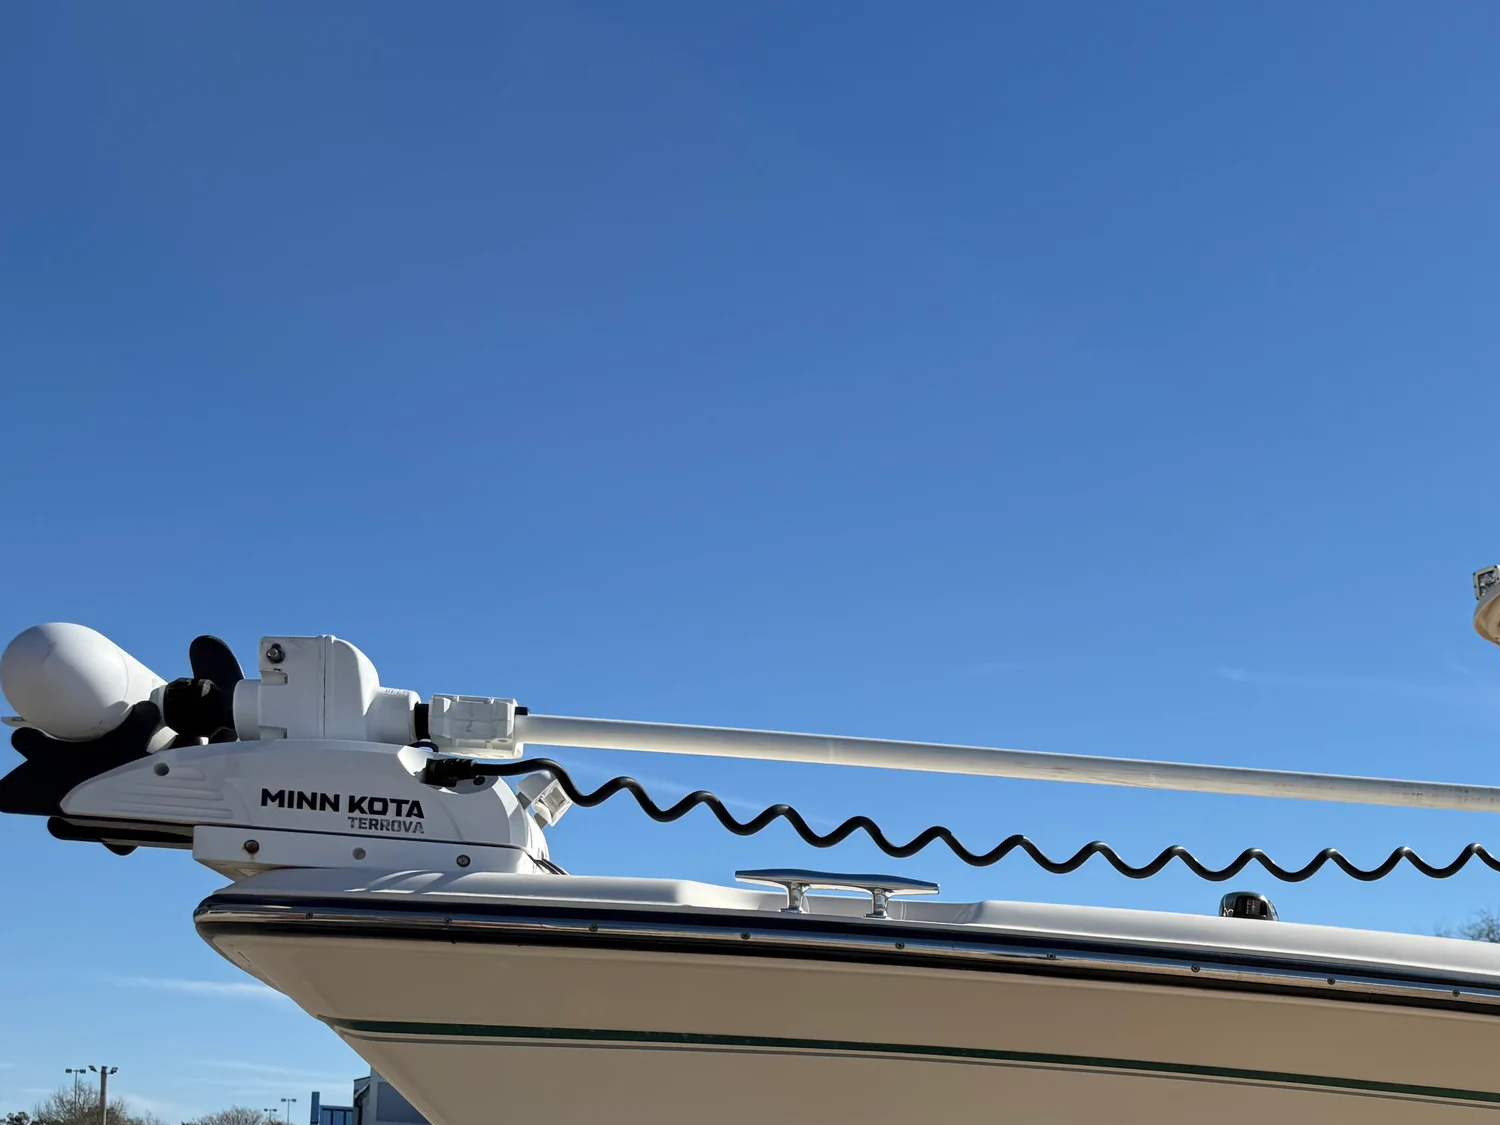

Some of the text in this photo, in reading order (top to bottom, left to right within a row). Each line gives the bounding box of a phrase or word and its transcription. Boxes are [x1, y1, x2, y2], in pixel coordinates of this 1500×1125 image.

[261, 788, 425, 819] MINN KOTA
[347, 816, 425, 834] TERROVA
